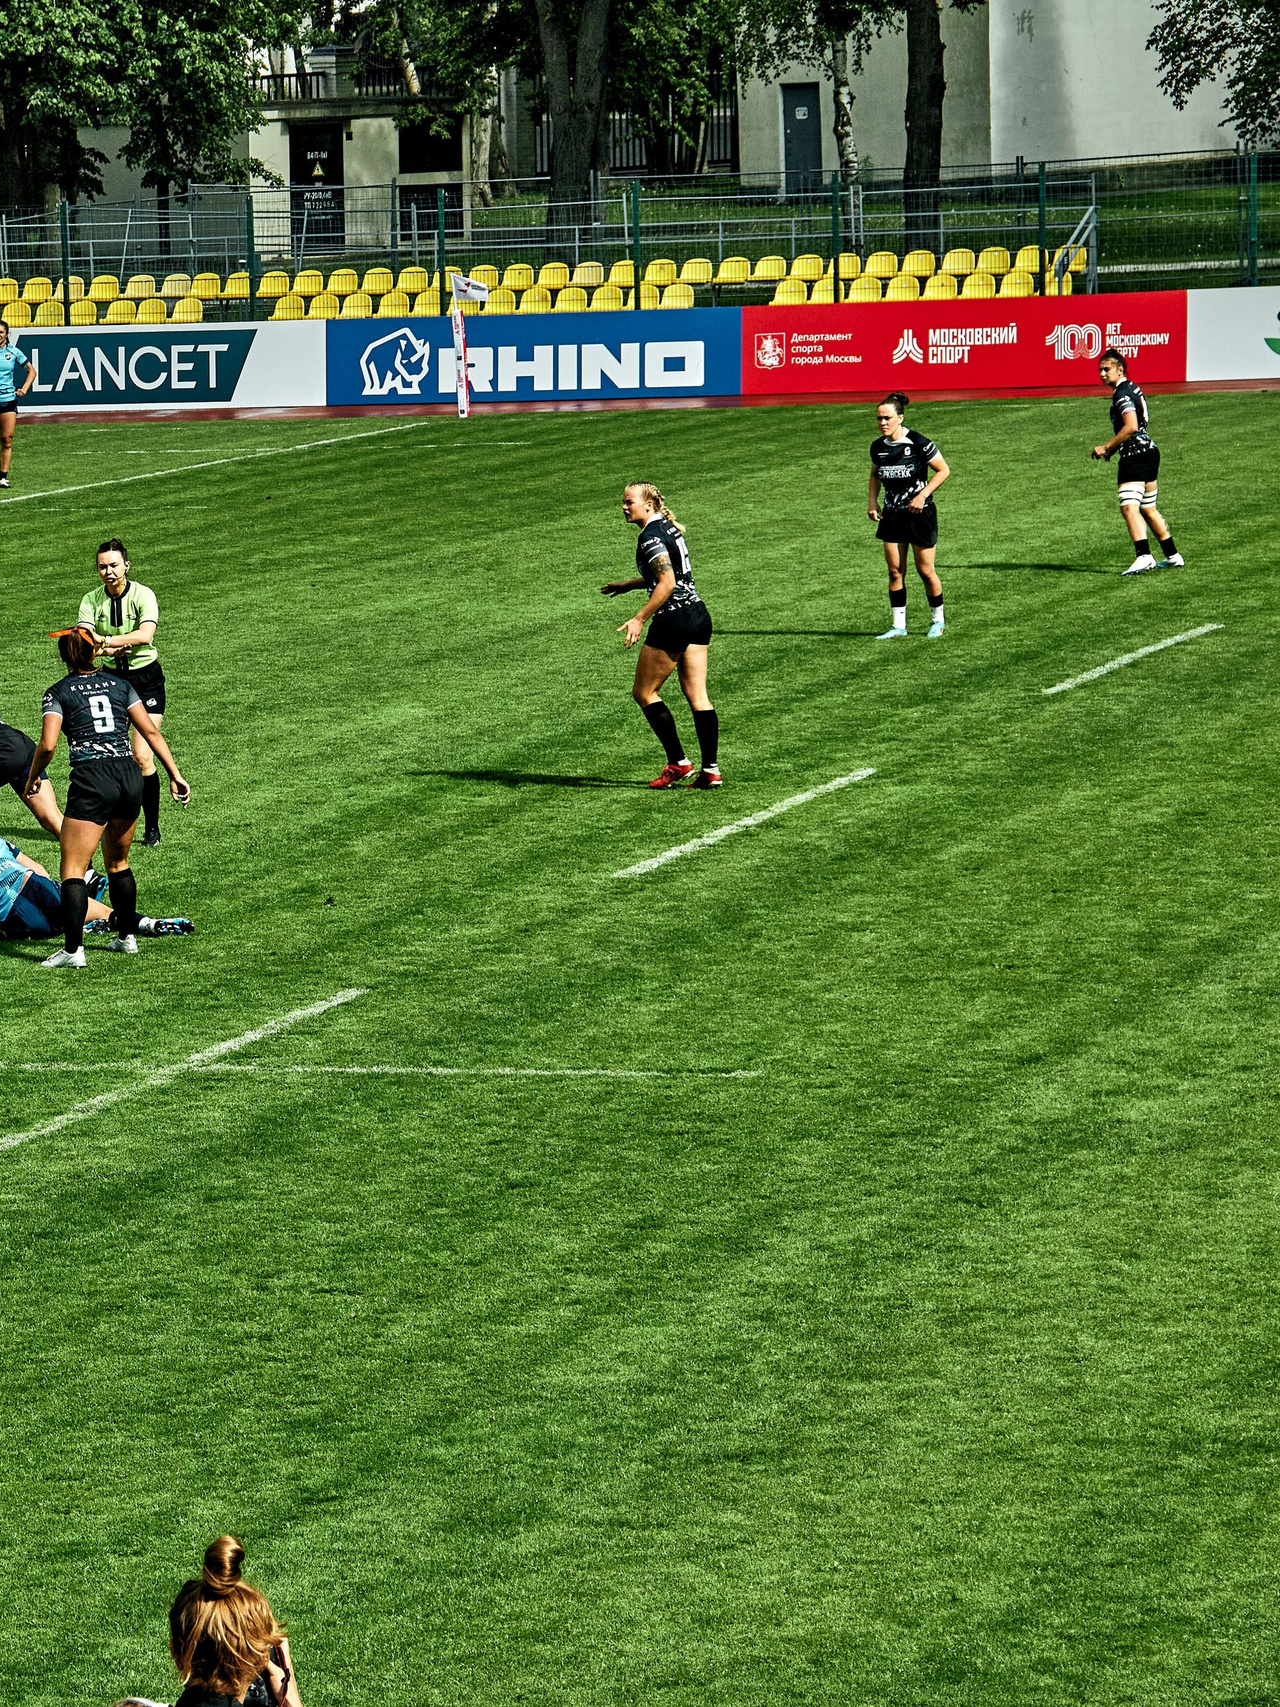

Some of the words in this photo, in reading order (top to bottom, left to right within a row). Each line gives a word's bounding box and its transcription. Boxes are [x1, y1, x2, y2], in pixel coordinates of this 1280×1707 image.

[928, 322, 1017, 346] МОСКОВСКИЙ
[1106, 323, 1121, 334] ЛЕТ
[791, 332, 853, 343] Департамент
[1045, 323, 1102, 360] 100
[1106, 333, 1170, 345] МОСКОВСКОМУ
[791, 344, 823, 354] спорта
[928, 346, 971, 364] СПОРТ
[1106, 346, 1139, 358] ОРТУ
[438, 340, 705, 394] RHINO
[791, 355, 824, 365] города
[825, 354, 862, 363] Москвы
[31, 344, 230, 393] LANCET
[88, 695, 115, 733] 9
